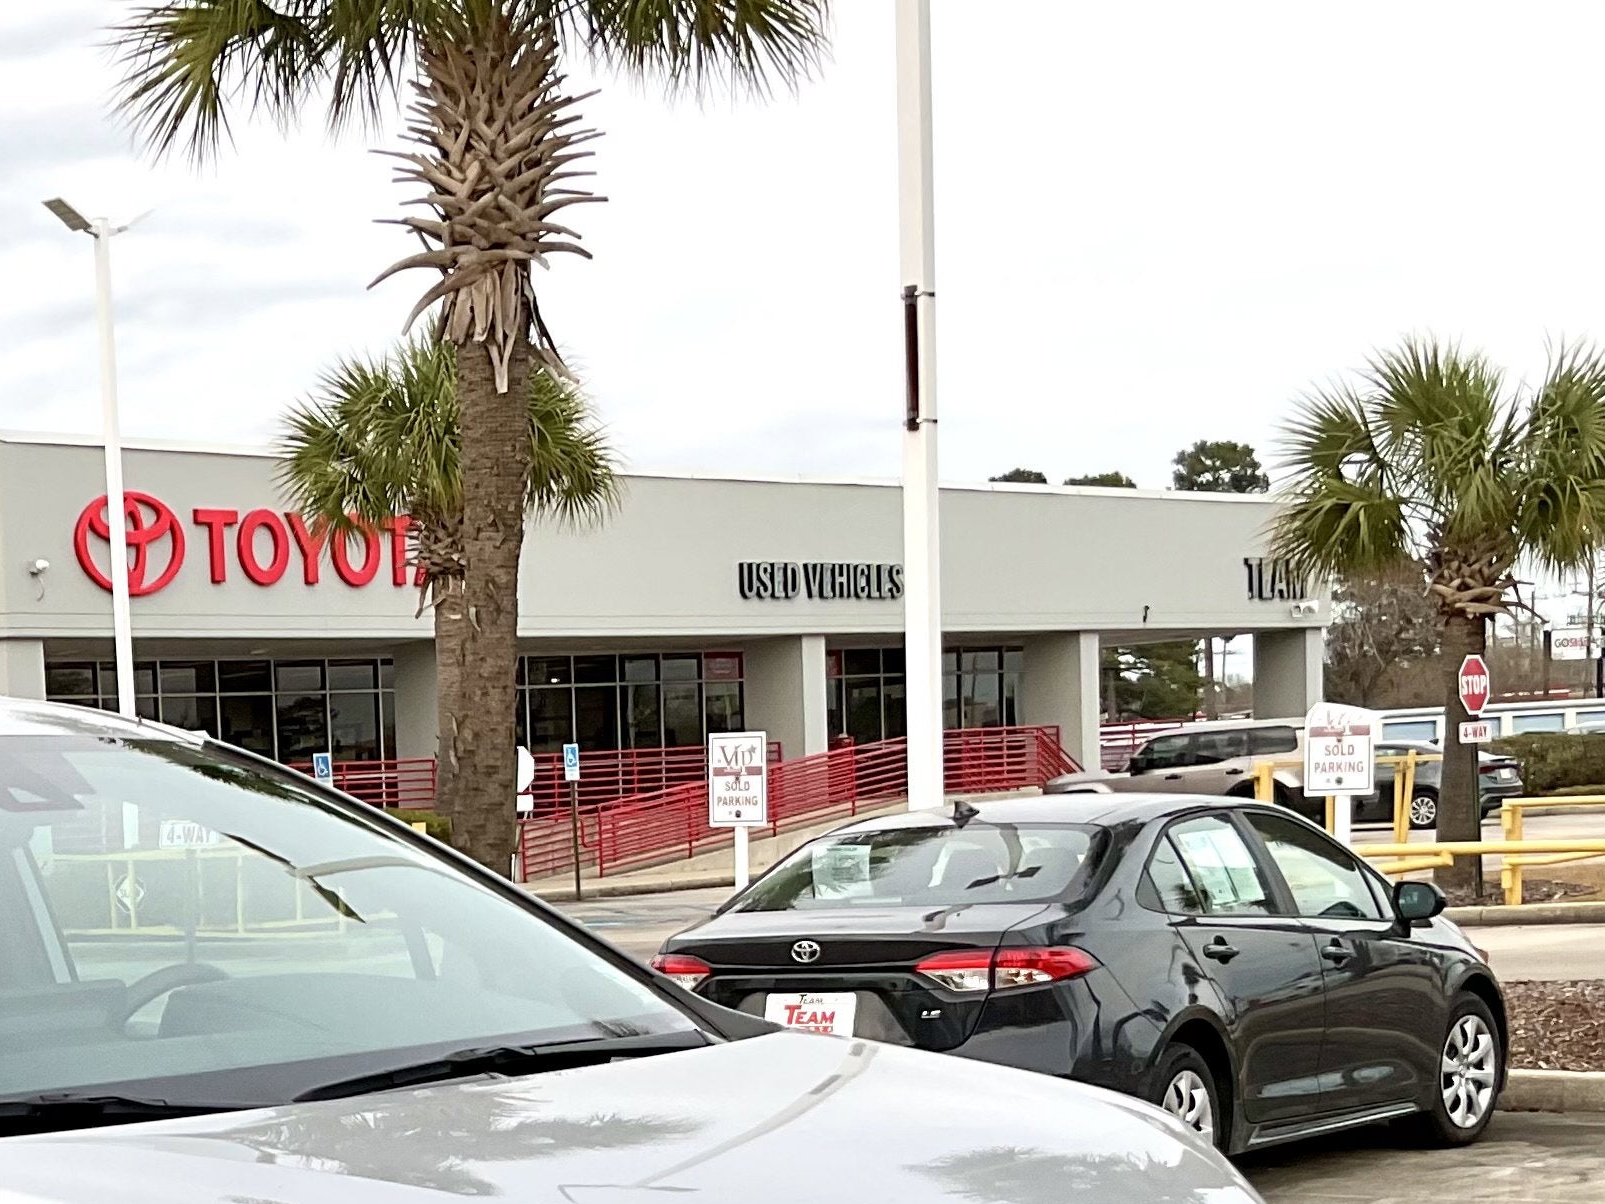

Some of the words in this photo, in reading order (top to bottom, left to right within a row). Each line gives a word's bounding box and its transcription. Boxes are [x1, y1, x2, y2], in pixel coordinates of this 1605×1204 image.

[193, 508, 429, 588] TOYOT
[738, 562, 801, 600] USED
[802, 563, 905, 600] VEHICLES
[1461, 674, 1487, 696] STOP
[1463, 725, 1487, 738] 4-WAY
[1324, 744, 1355, 756] SOLD
[1314, 760, 1364, 773] PARKING
[724, 780, 751, 791] SOLD
[716, 795, 758, 806] PARKING
[784, 1004, 836, 1025] TEAM
